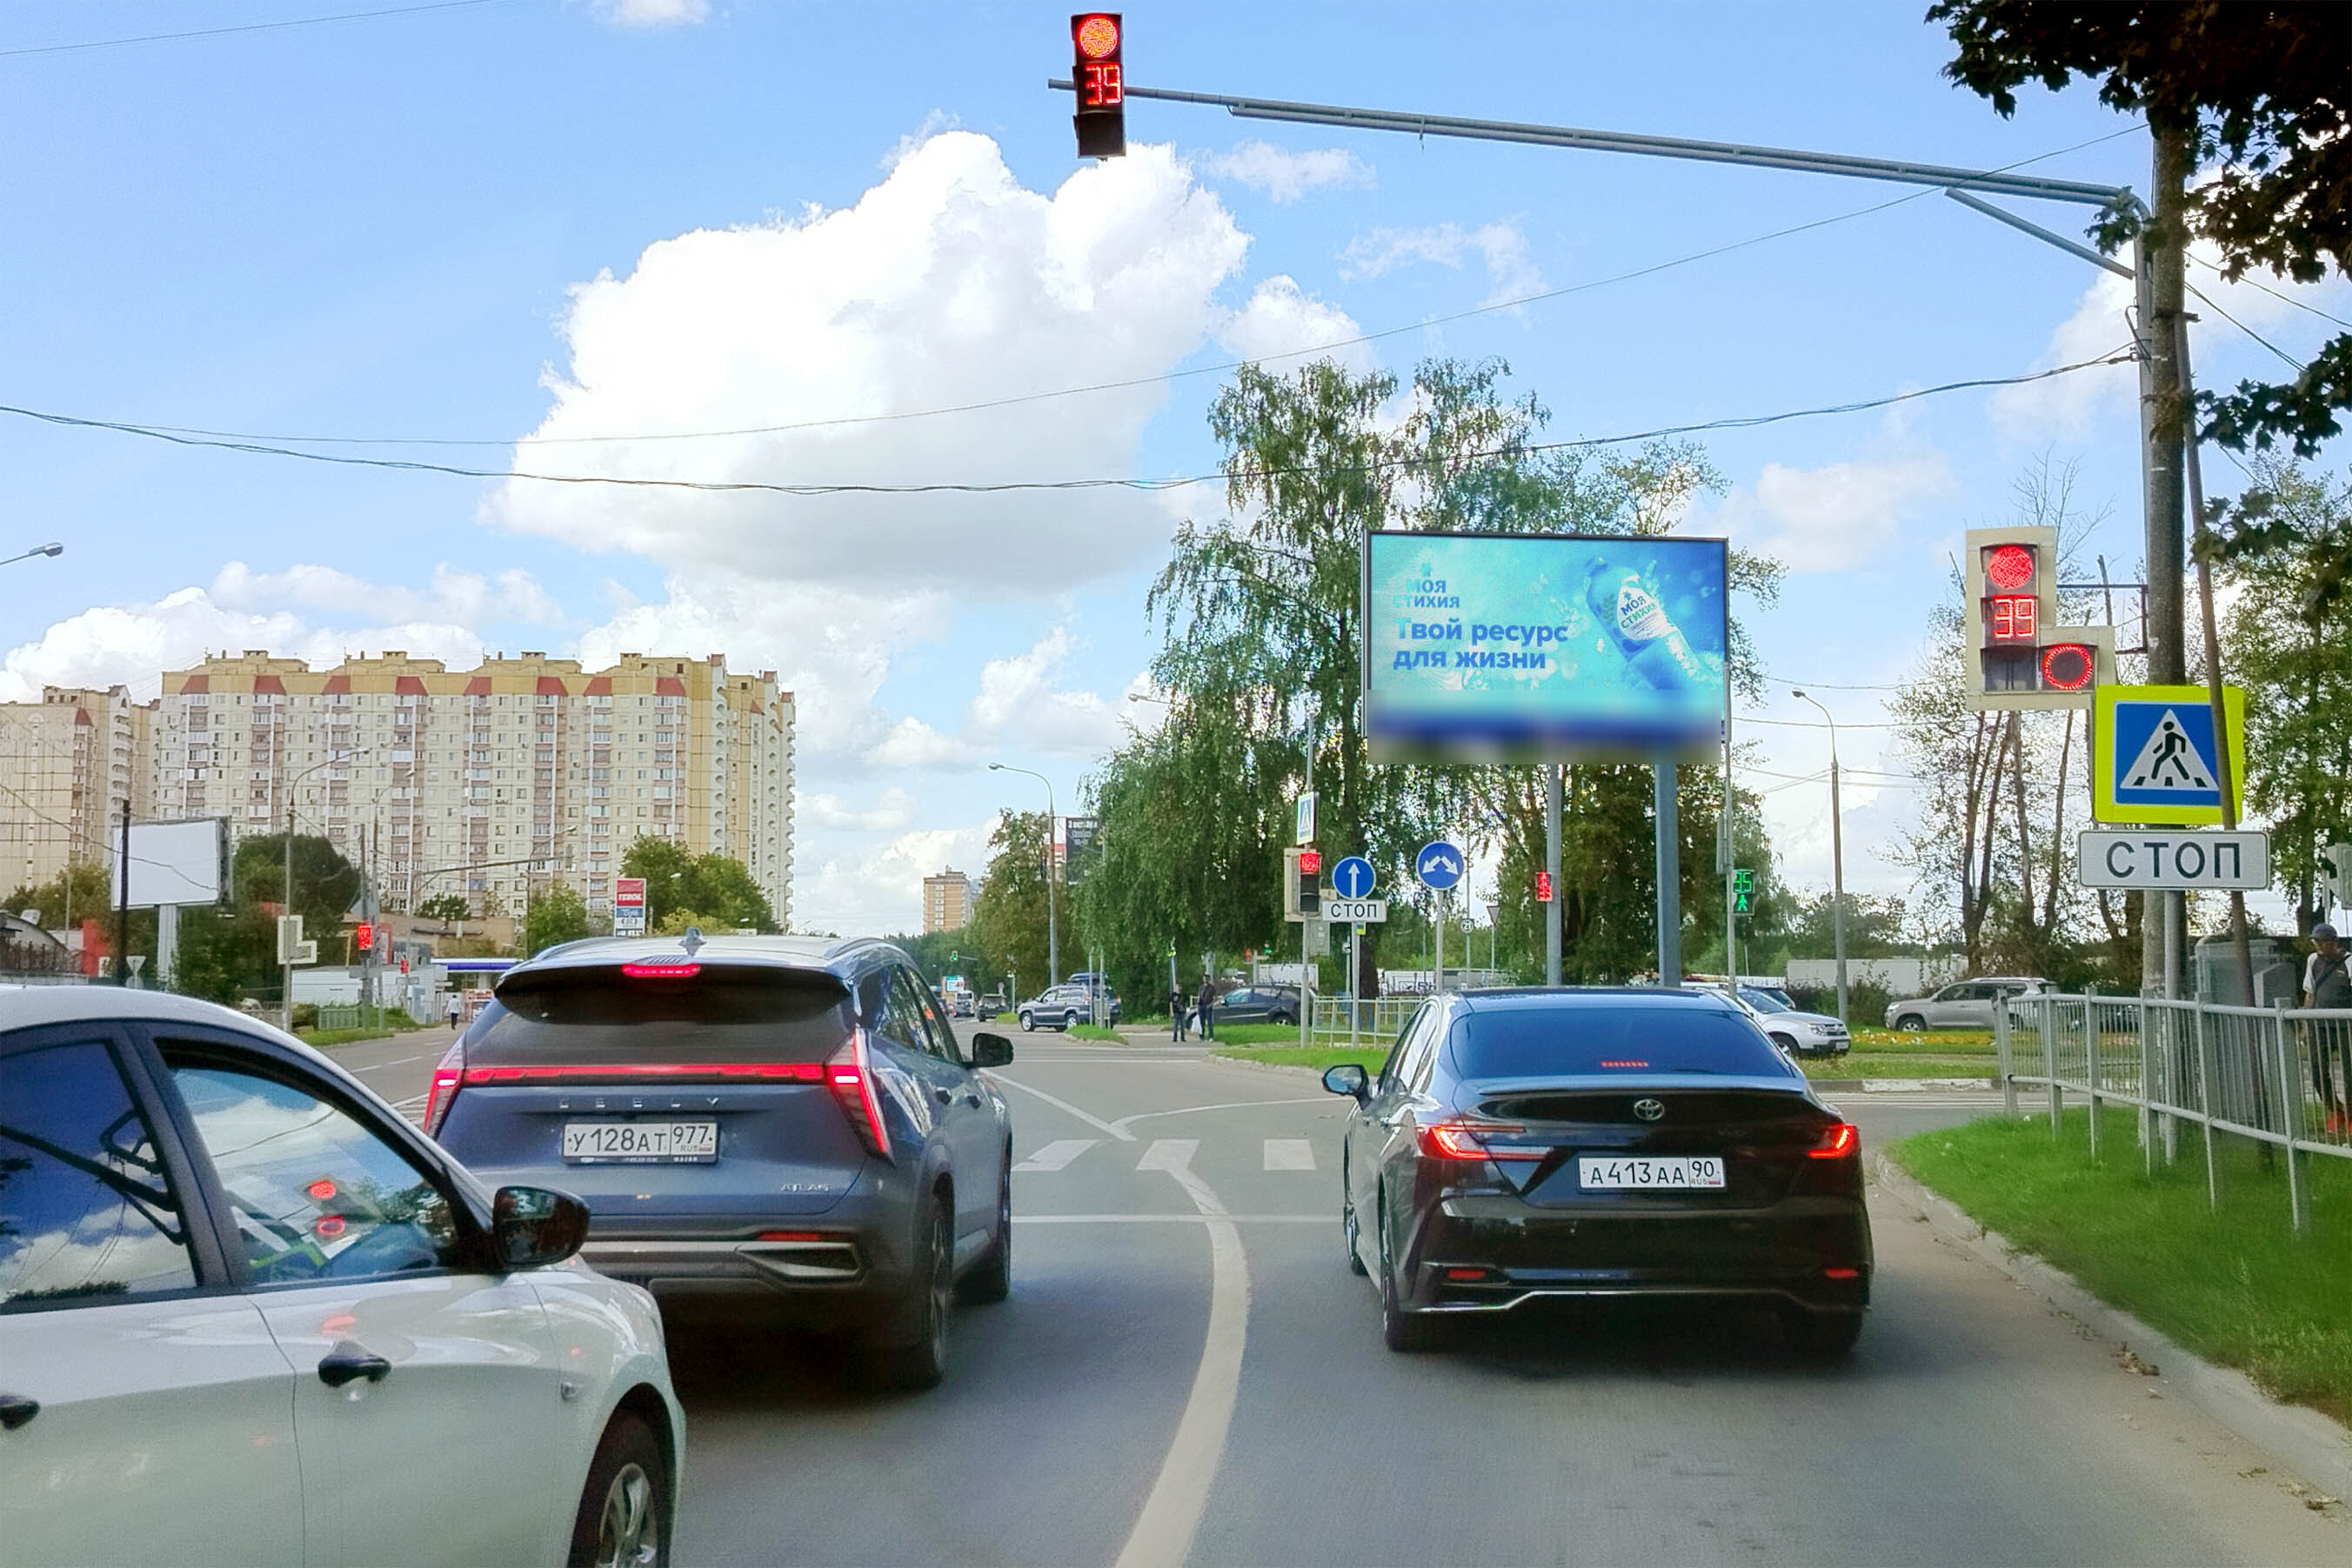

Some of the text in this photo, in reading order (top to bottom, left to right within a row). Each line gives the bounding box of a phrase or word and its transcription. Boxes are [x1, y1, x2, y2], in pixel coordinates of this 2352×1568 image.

[1086, 65, 1122, 104] 39
[1407, 579, 1447, 593] МОЯ
[1393, 595, 1460, 608] СТИХИЯ
[1620, 596, 1647, 616] МОЯ
[1995, 598, 2035, 638] 39
[1393, 617, 1568, 647] Твой ресурс
[1393, 651, 1546, 671] для жизни
[2106, 841, 2242, 878] СТОП
[1331, 904, 1377, 917] СТОП
